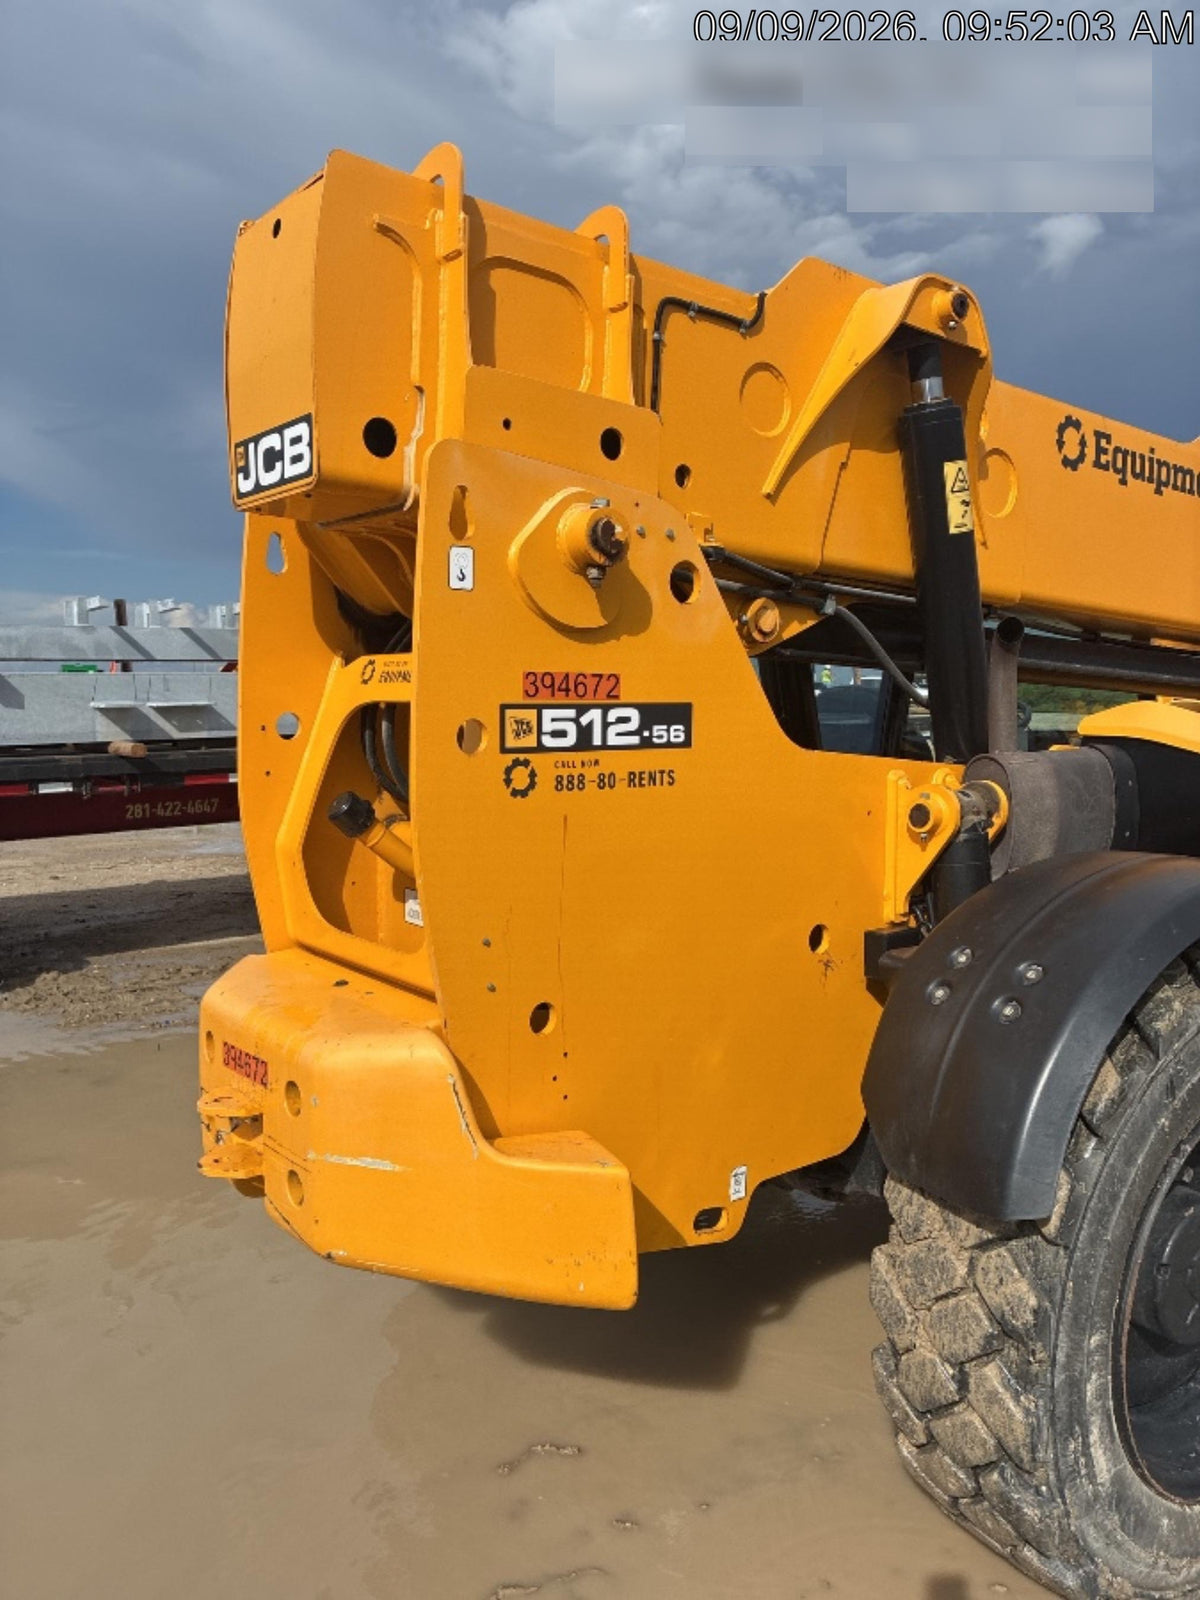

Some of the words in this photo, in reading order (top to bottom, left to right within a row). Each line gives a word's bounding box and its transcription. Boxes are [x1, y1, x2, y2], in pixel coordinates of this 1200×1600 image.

[237, 422, 311, 493] JCB
[1092, 429, 1200, 498] Equipm
[524, 671, 620, 698] 394672
[554, 769, 676, 792] 888-80-RENTS
[223, 1041, 268, 1089] 394672
